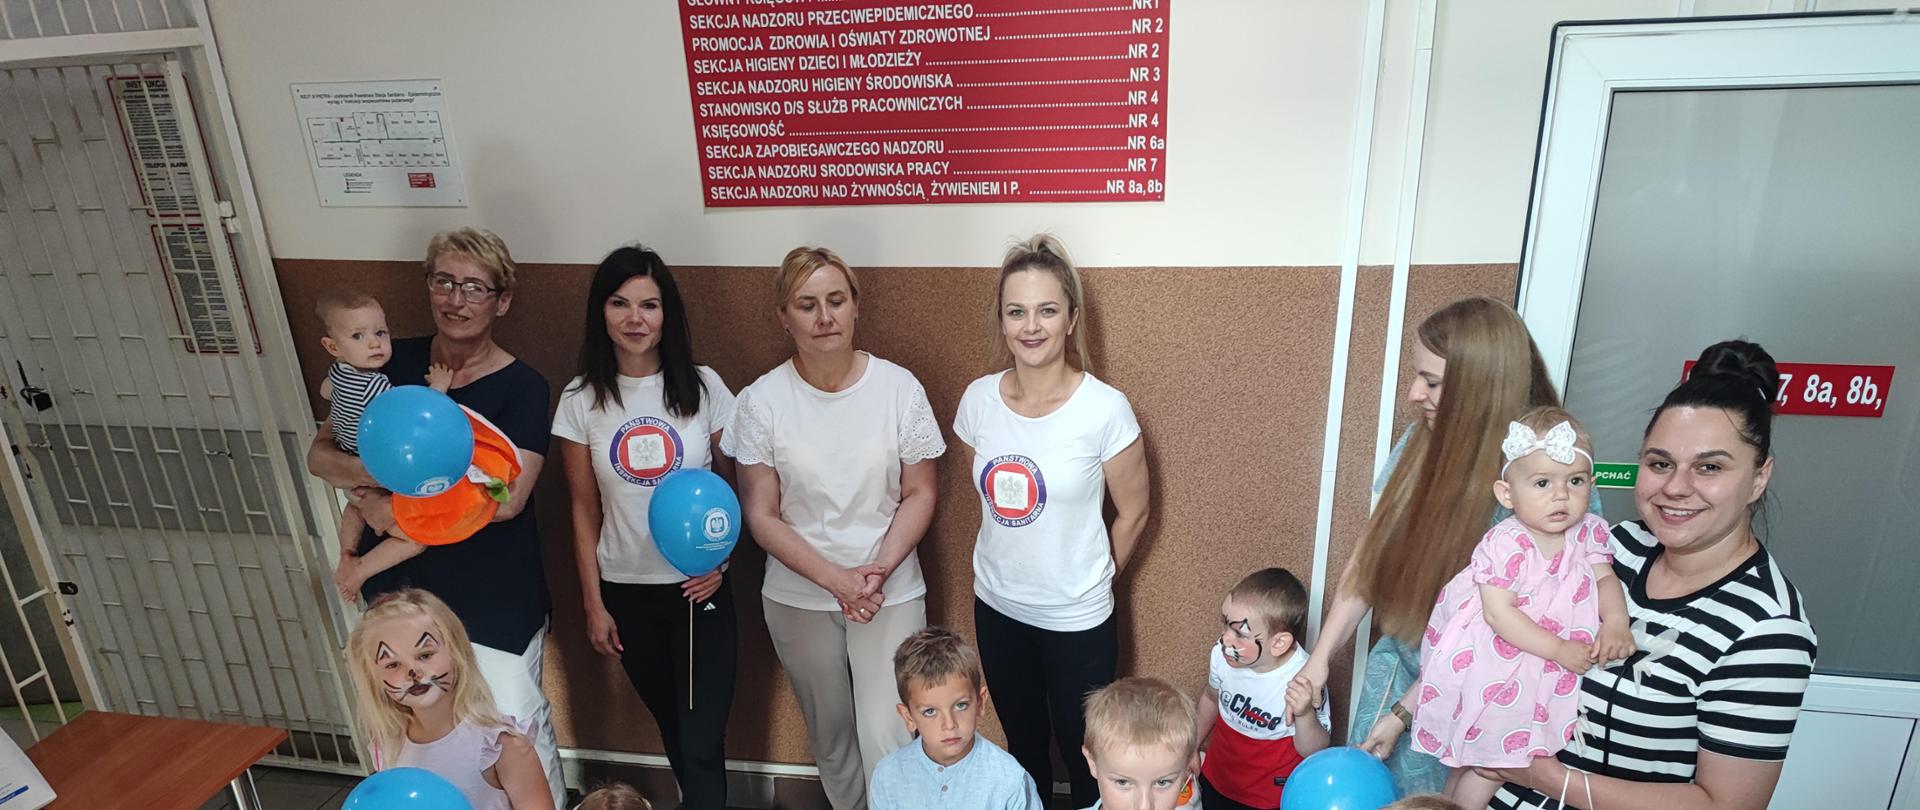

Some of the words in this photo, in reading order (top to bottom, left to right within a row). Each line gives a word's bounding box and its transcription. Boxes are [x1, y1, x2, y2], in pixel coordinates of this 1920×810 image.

[690, 15, 739, 29] SEKCJA
[743, 12, 804, 27] NADZORU
[808, 4, 973, 25] PRZECIWEPIDEMICZNEGO
[693, 37, 763, 51] PROMOCJA
[769, 34, 829, 50] ZDROWIA
[831, 34, 836, 47] I
[839, 29, 895, 47] OŚWIATY
[900, 26, 990, 44] ZDROWOTNEJ
[1155, 17, 1163, 33] 2
[694, 59, 743, 73] SEKCJA
[746, 57, 795, 71] HIGIENY
[799, 55, 839, 70] DZIECI
[842, 55, 847, 68] I
[850, 49, 921, 68] MŁODZIEŻY
[1152, 43, 1159, 58] 2
[697, 81, 745, 95] SEKCJA
[748, 79, 808, 93] NADZORU
[812, 77, 862, 91] HIGIENY
[866, 73, 953, 90] ŚRODOWISKA
[1153, 67, 1160, 81] 3
[700, 102, 780, 117] STANOWISKO
[784, 101, 804, 114] D/S
[808, 97, 848, 114] SŁUŻB
[852, 96, 962, 112] PRACOWNICZYCH
[1151, 90, 1158, 104] 4
[703, 120, 785, 141] KSIĘGOWOŚĆ
[1151, 113, 1159, 127] 4
[706, 145, 753, 158] SEKCJA
[756, 142, 879, 157] ZAPOBIEGAWCZEGO
[884, 140, 944, 154] NADZORU
[1150, 136, 1164, 150] 6a
[709, 166, 756, 179] SEKCJA
[758, 165, 816, 178] NADZORU
[907, 162, 949, 175] PRACY
[1150, 158, 1157, 172] 7
[711, 187, 758, 199] SEKCJA
[761, 186, 818, 198] NADZORU
[823, 185, 847, 197] NAD
[851, 181, 925, 199] ŻYWNOŚCIĄ
[931, 180, 1000, 195] ŻYWIENIEM
[1003, 182, 1008, 194] I
[1803, 374, 1837, 408] 8a,
[1846, 375, 1882, 410] 8b,
[1595, 470, 1632, 480] PCHAĆ
[1230, 693, 1281, 731] Chase
